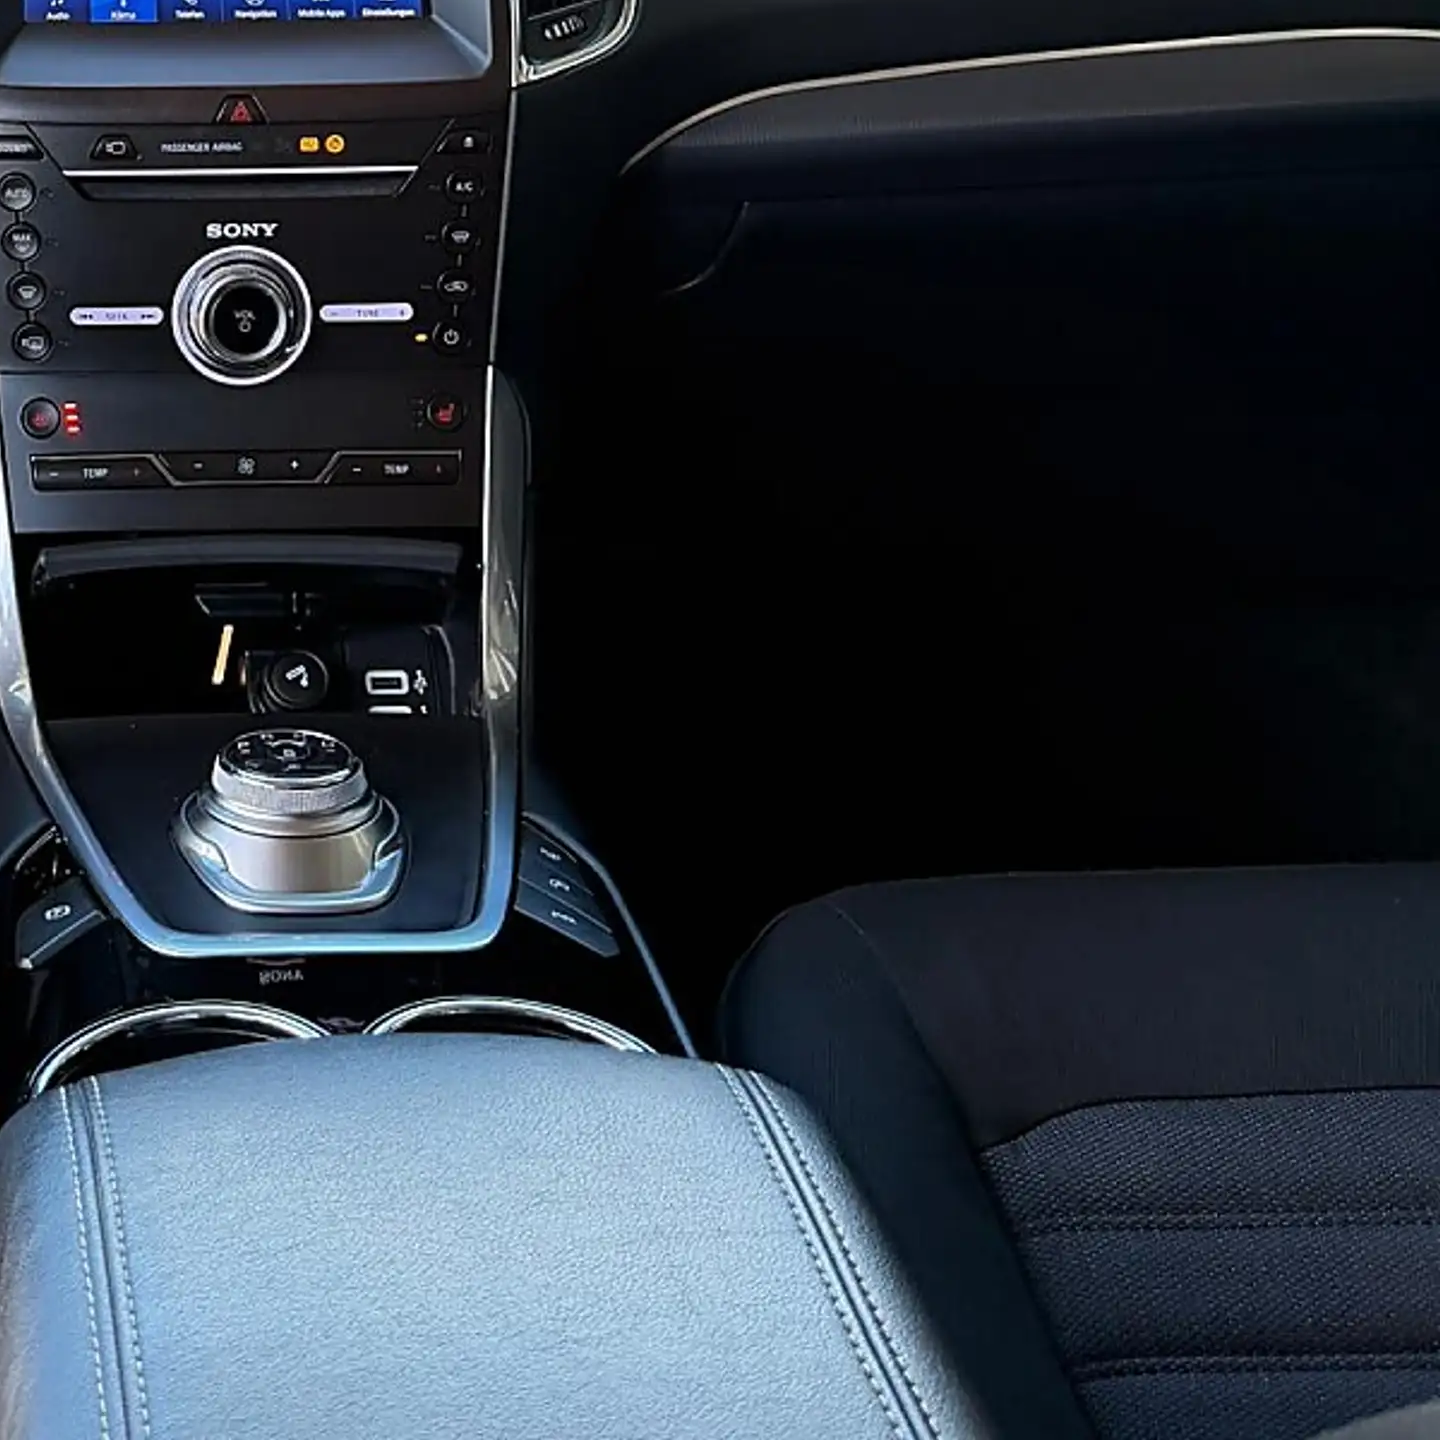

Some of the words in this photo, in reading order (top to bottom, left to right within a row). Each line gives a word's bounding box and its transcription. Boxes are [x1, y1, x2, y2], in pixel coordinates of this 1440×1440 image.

[206, 223, 278, 238] SONY
[83, 467, 109, 479] TEMP
[383, 464, 410, 475] TEMP
